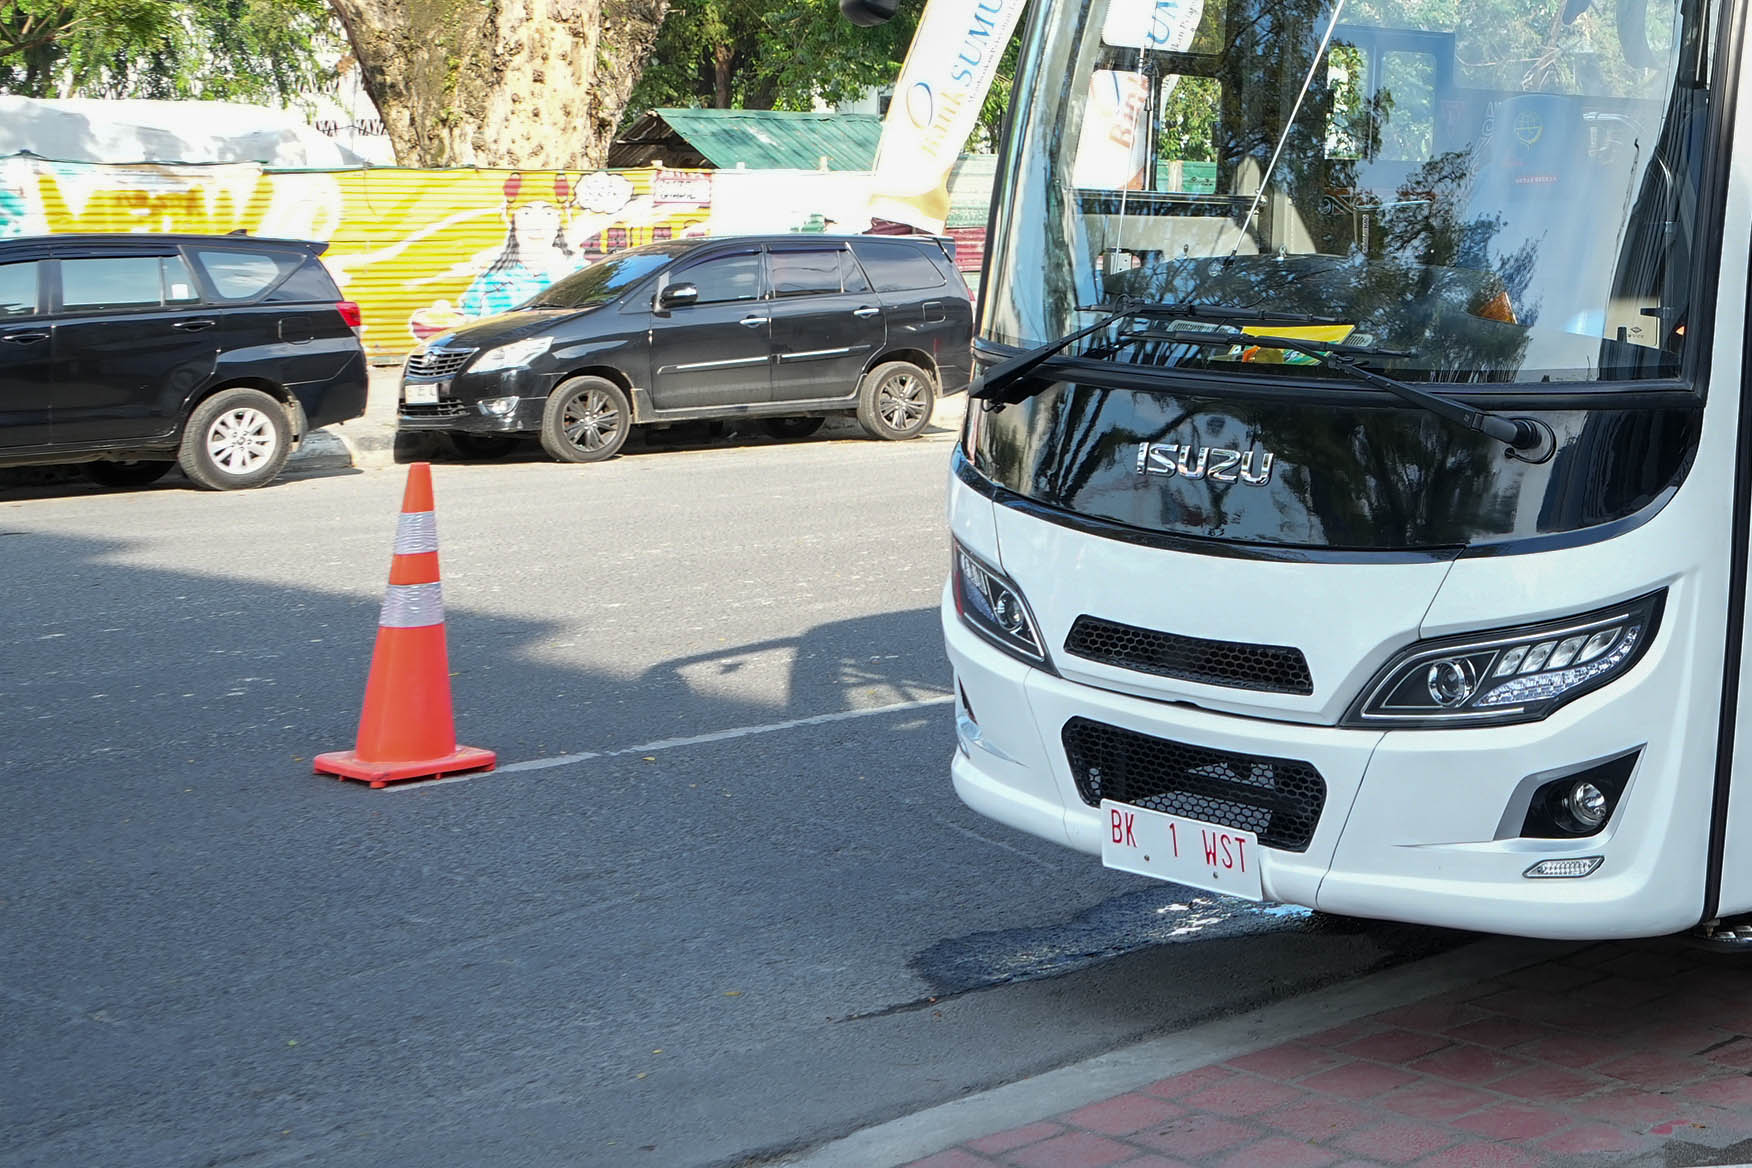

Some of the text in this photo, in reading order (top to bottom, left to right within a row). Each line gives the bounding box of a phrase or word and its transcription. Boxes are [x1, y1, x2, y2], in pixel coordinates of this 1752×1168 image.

[1137, 442, 1274, 487] ISUZU
[1111, 809, 1246, 873] BK 1 WST
